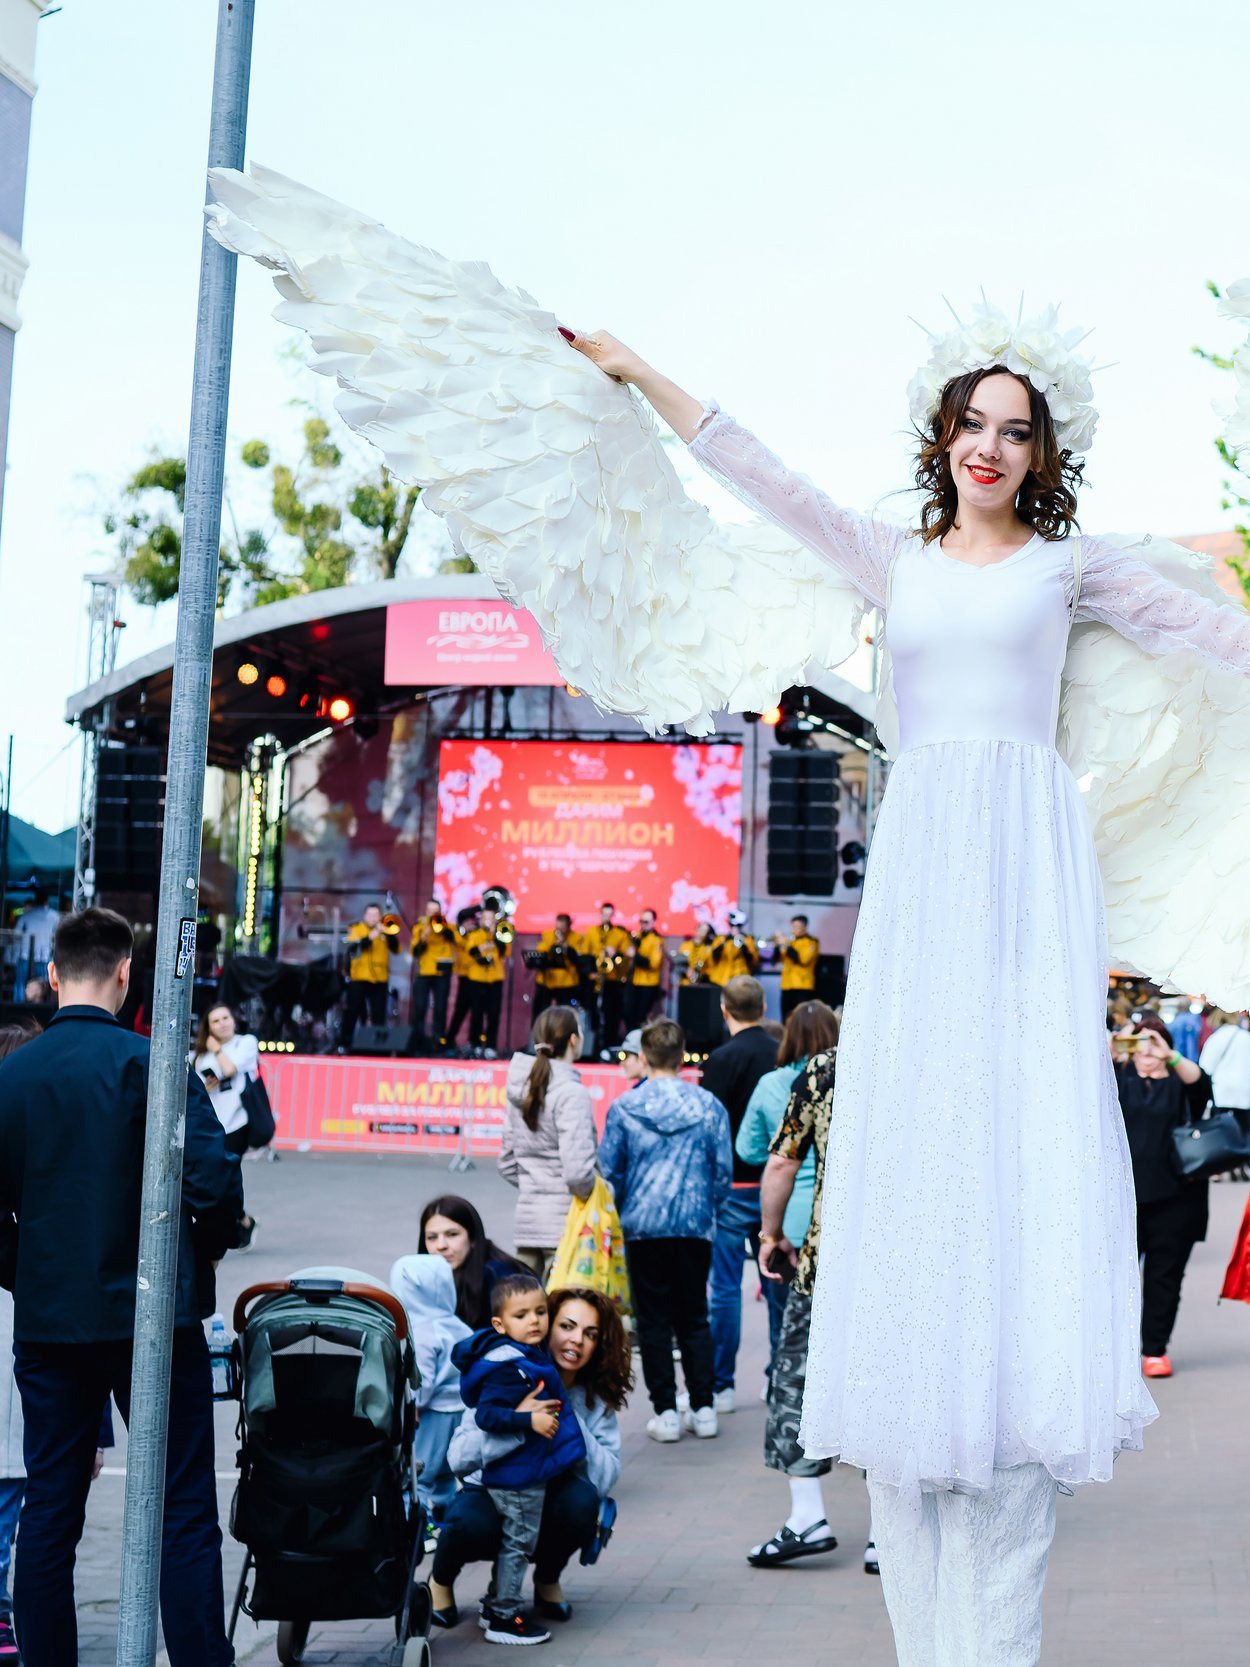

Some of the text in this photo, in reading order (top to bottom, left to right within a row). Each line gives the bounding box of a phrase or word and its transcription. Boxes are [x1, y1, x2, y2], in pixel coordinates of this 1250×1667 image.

[438, 611, 517, 632] ЕВРОПА
[501, 820, 675, 846] МИЛЛИОН
[378, 1082, 508, 1105] МИЛЛИ
